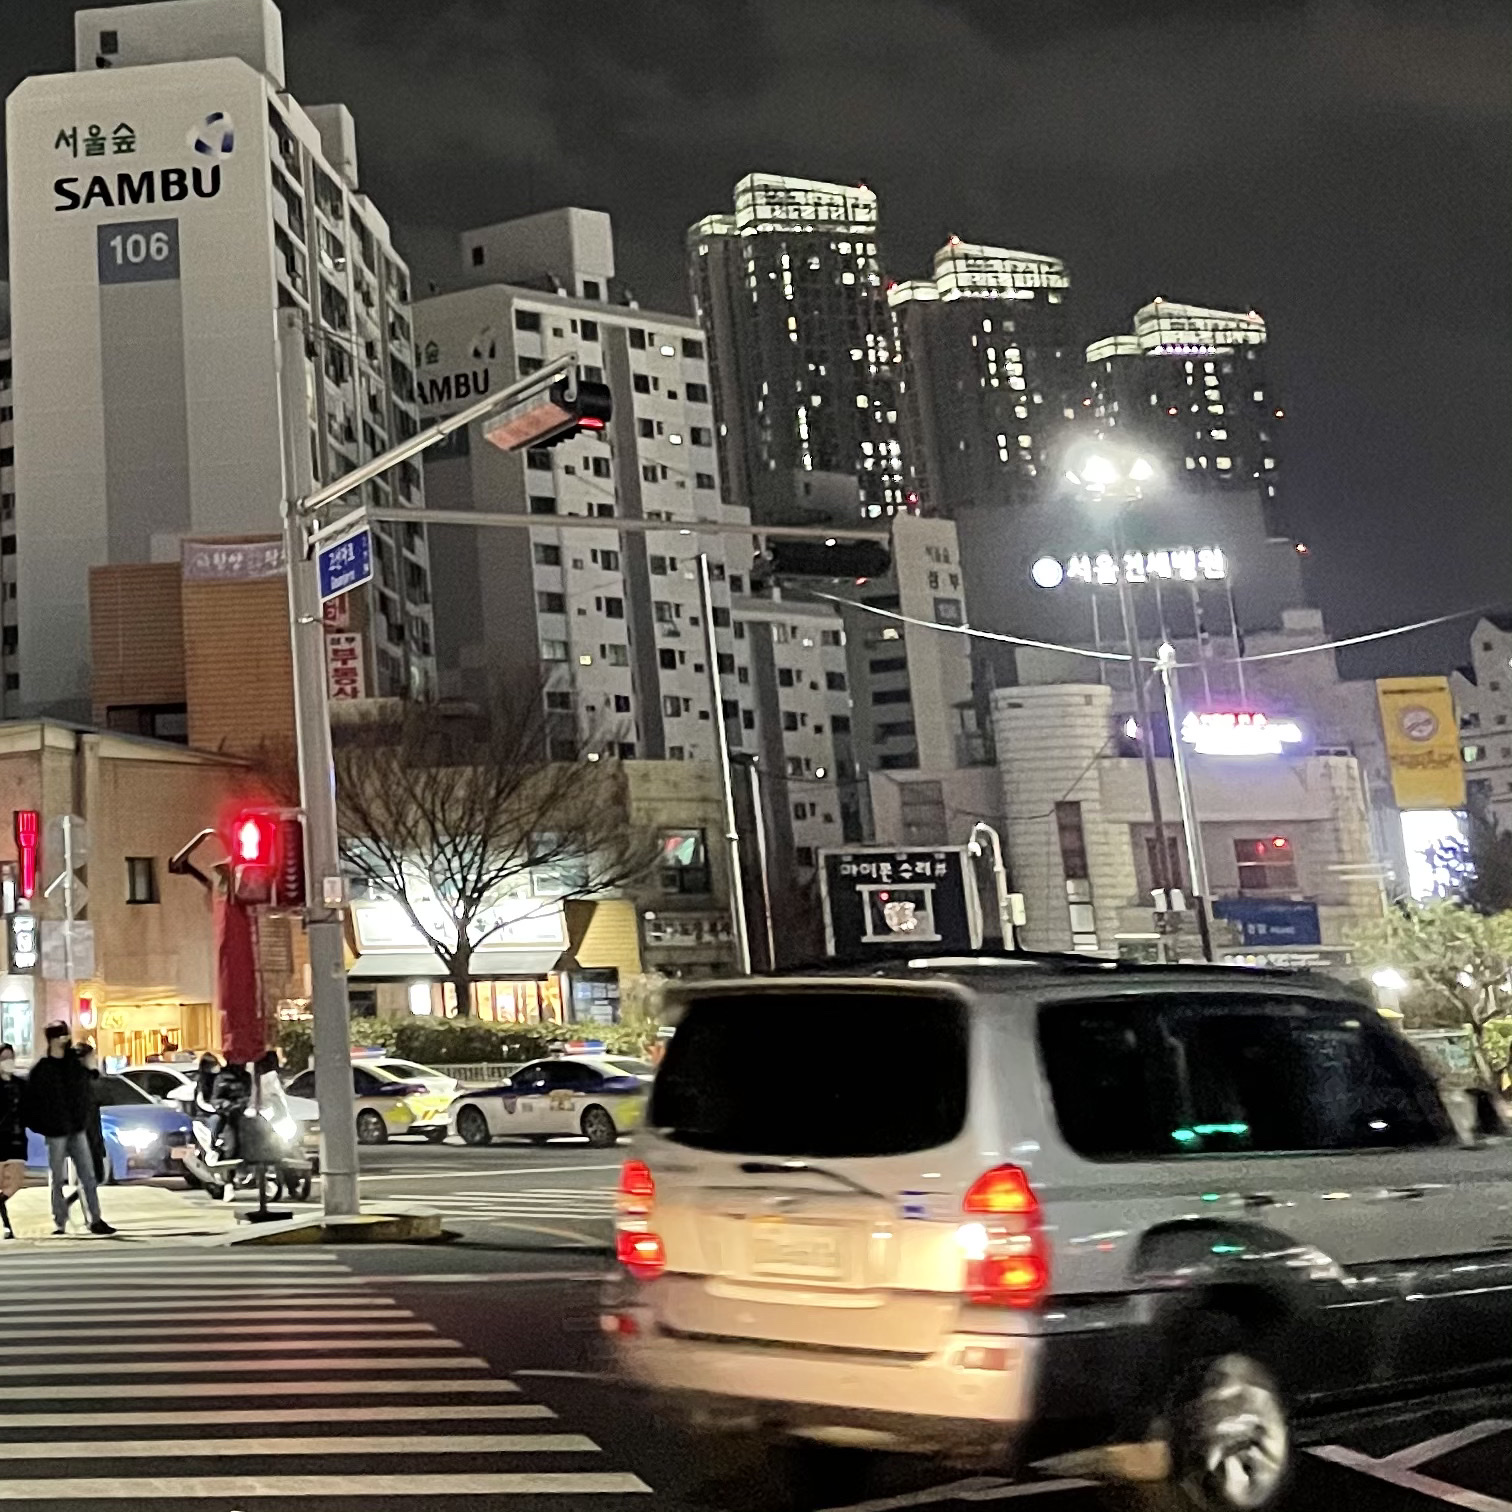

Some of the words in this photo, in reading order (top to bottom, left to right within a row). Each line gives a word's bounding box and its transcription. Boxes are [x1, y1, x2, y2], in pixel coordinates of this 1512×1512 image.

[54, 122, 137, 159] 서울숲
[53, 164, 221, 212] SAMBU
[109, 231, 170, 266] 106
[416, 368, 489, 405] AMBU
